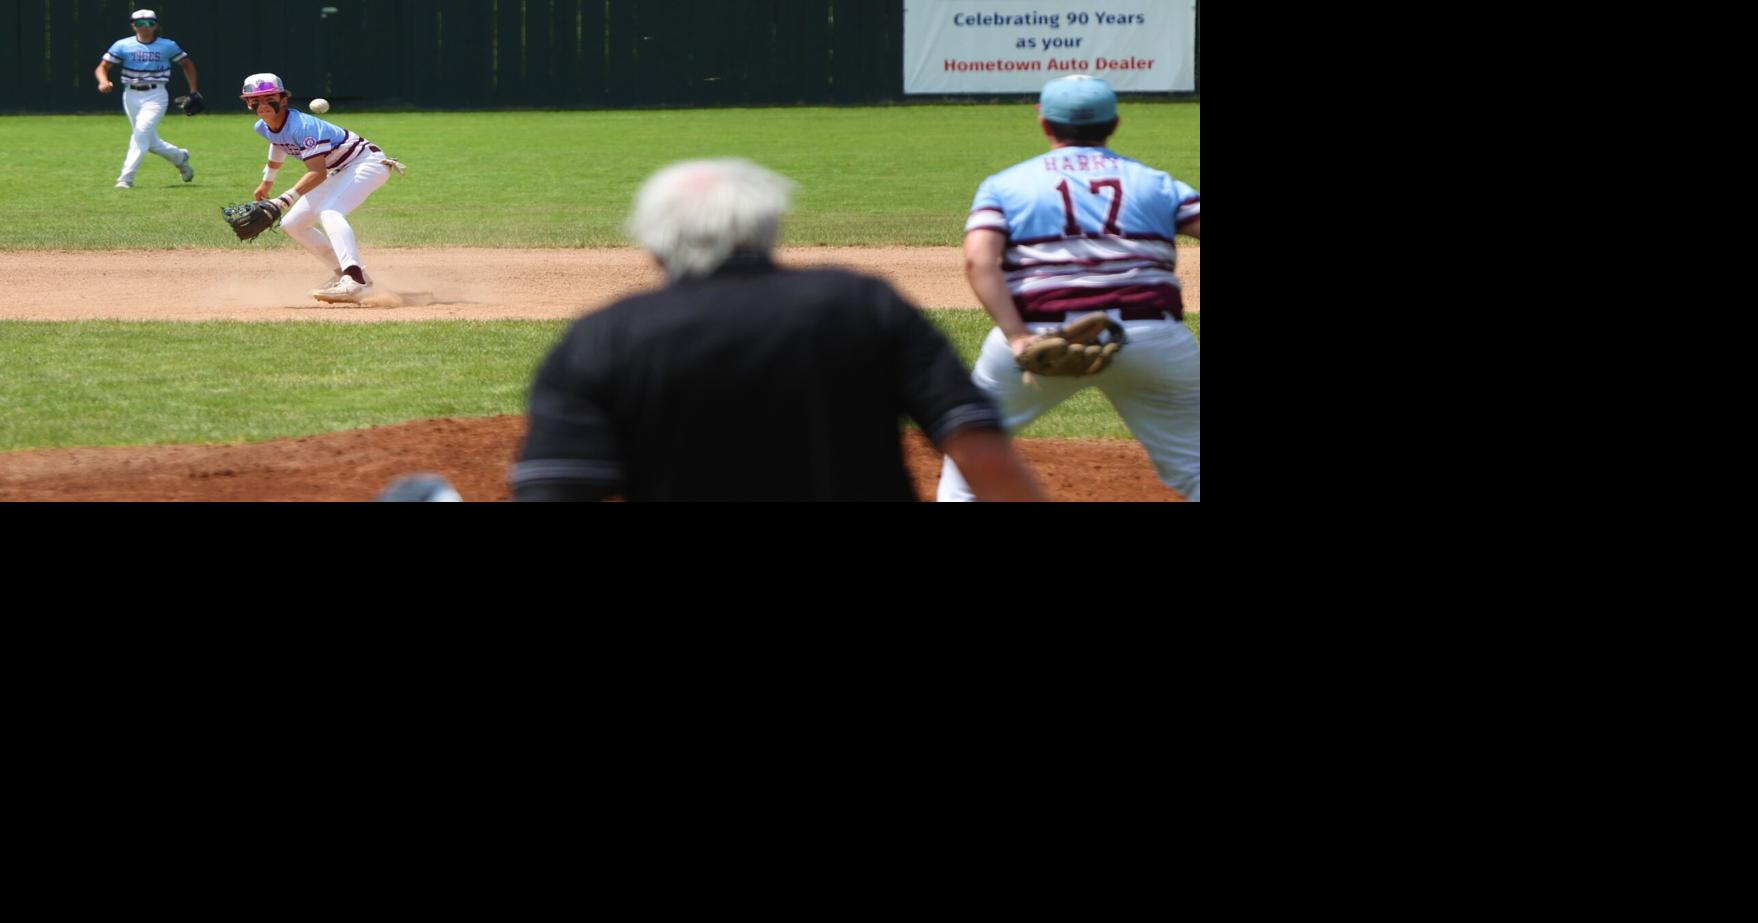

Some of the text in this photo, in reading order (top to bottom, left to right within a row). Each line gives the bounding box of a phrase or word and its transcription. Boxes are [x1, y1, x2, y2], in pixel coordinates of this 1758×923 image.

[953, 11, 1145, 28] Celebrating 90 Years
[1016, 36, 1083, 50] as your
[944, 56, 1155, 71] Hometown Auto Dealer
[1055, 177, 1122, 236] 17
